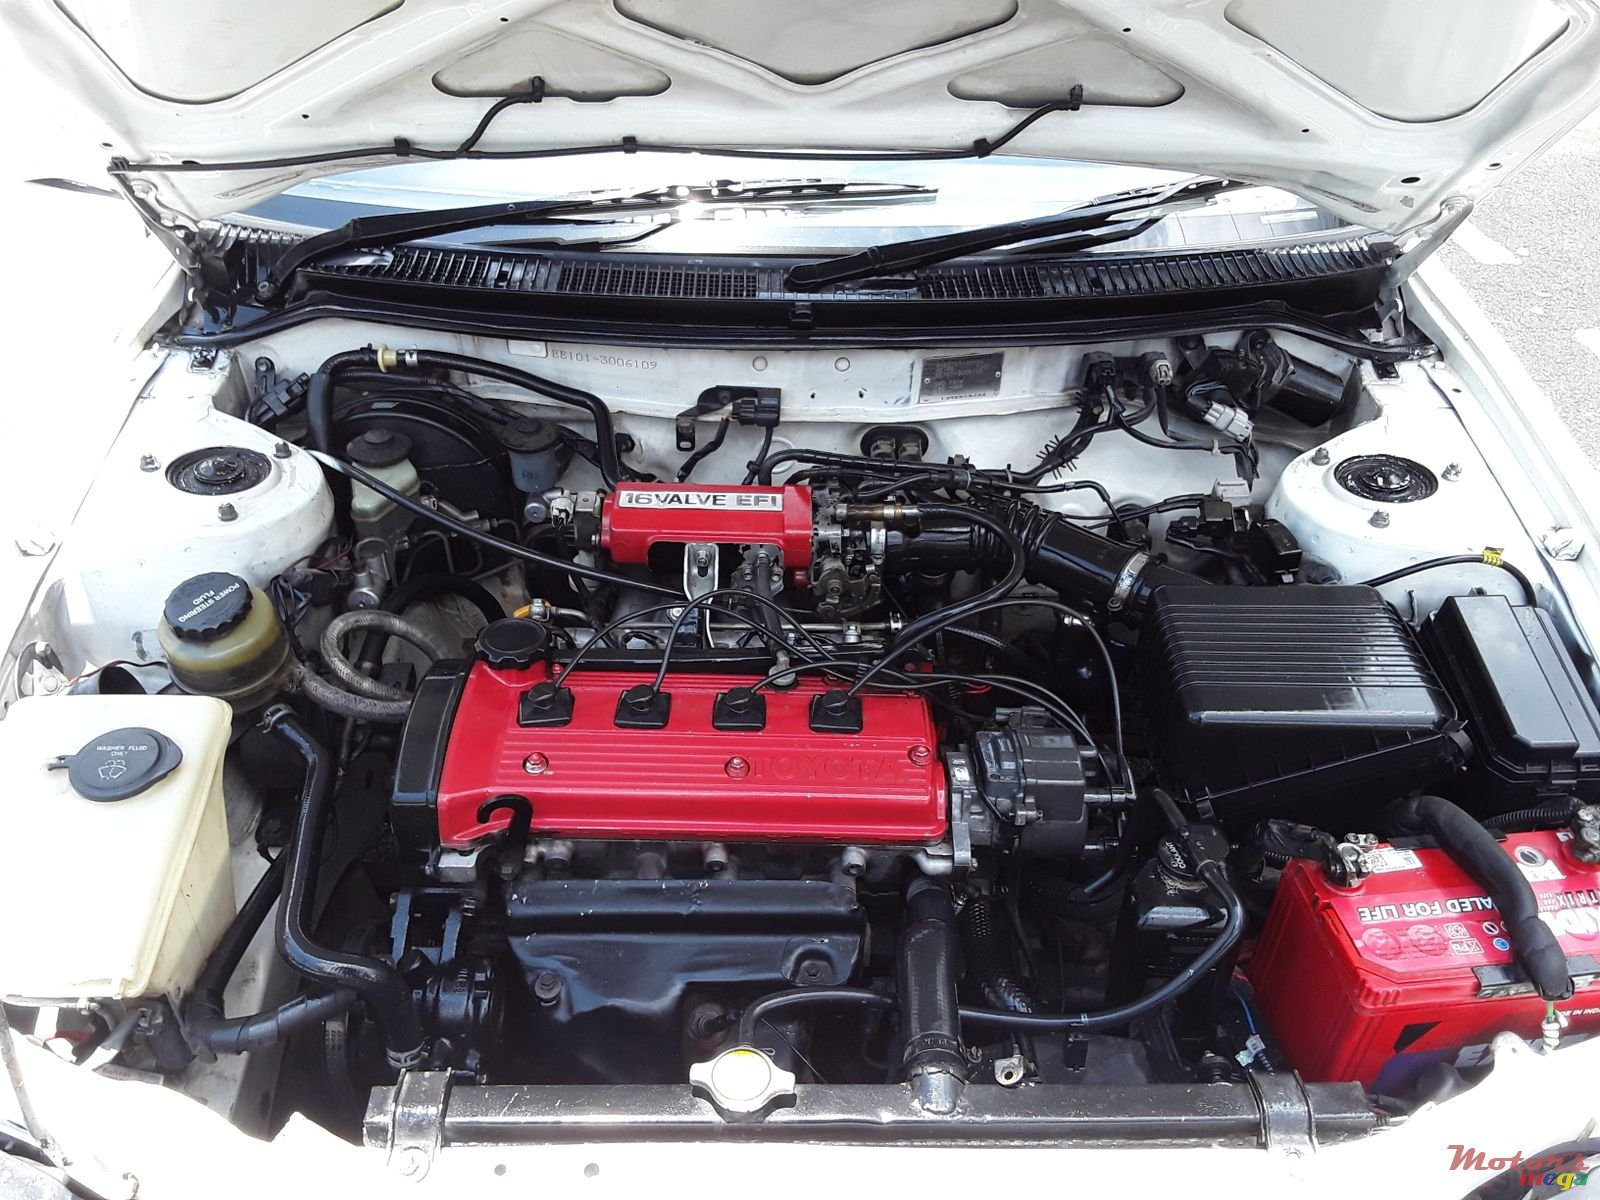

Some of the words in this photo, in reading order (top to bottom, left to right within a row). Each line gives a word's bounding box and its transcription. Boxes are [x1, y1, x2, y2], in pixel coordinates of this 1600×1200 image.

[736, 494, 778, 507] EFI
[192, 589, 216, 606] FLUID
[213, 582, 241, 602] POWER
[177, 598, 216, 623] STEERING
[752, 755, 900, 780] TOYOTA
[1358, 904, 1399, 923] LIFE
[1402, 900, 1443, 919] FOR
